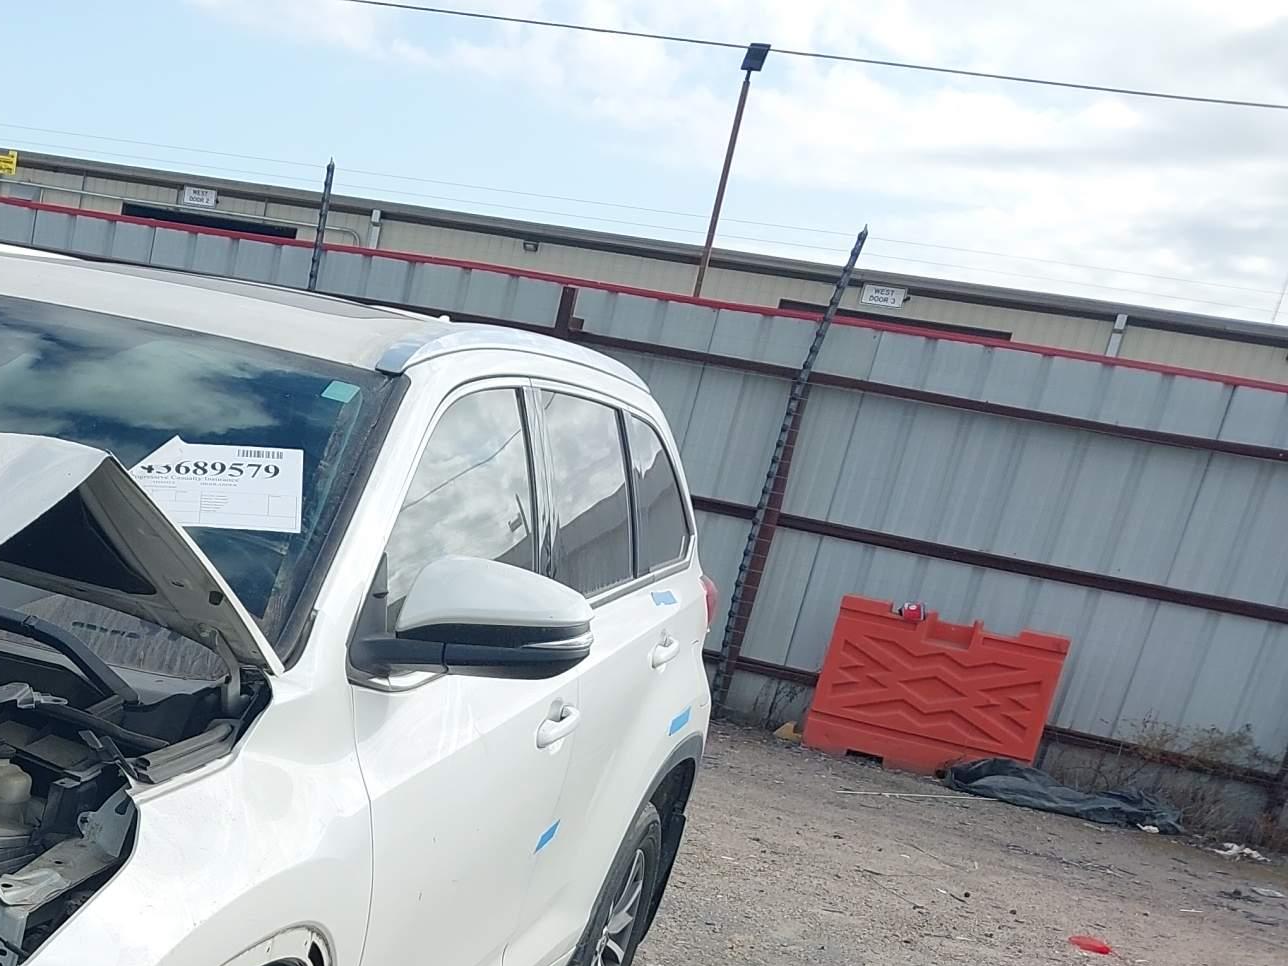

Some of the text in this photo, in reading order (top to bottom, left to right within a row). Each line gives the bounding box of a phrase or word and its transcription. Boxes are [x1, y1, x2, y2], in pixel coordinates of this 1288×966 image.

[874, 287, 894, 296] WEST
[868, 295, 889, 303] DOOR
[140, 460, 280, 480] 43689579
